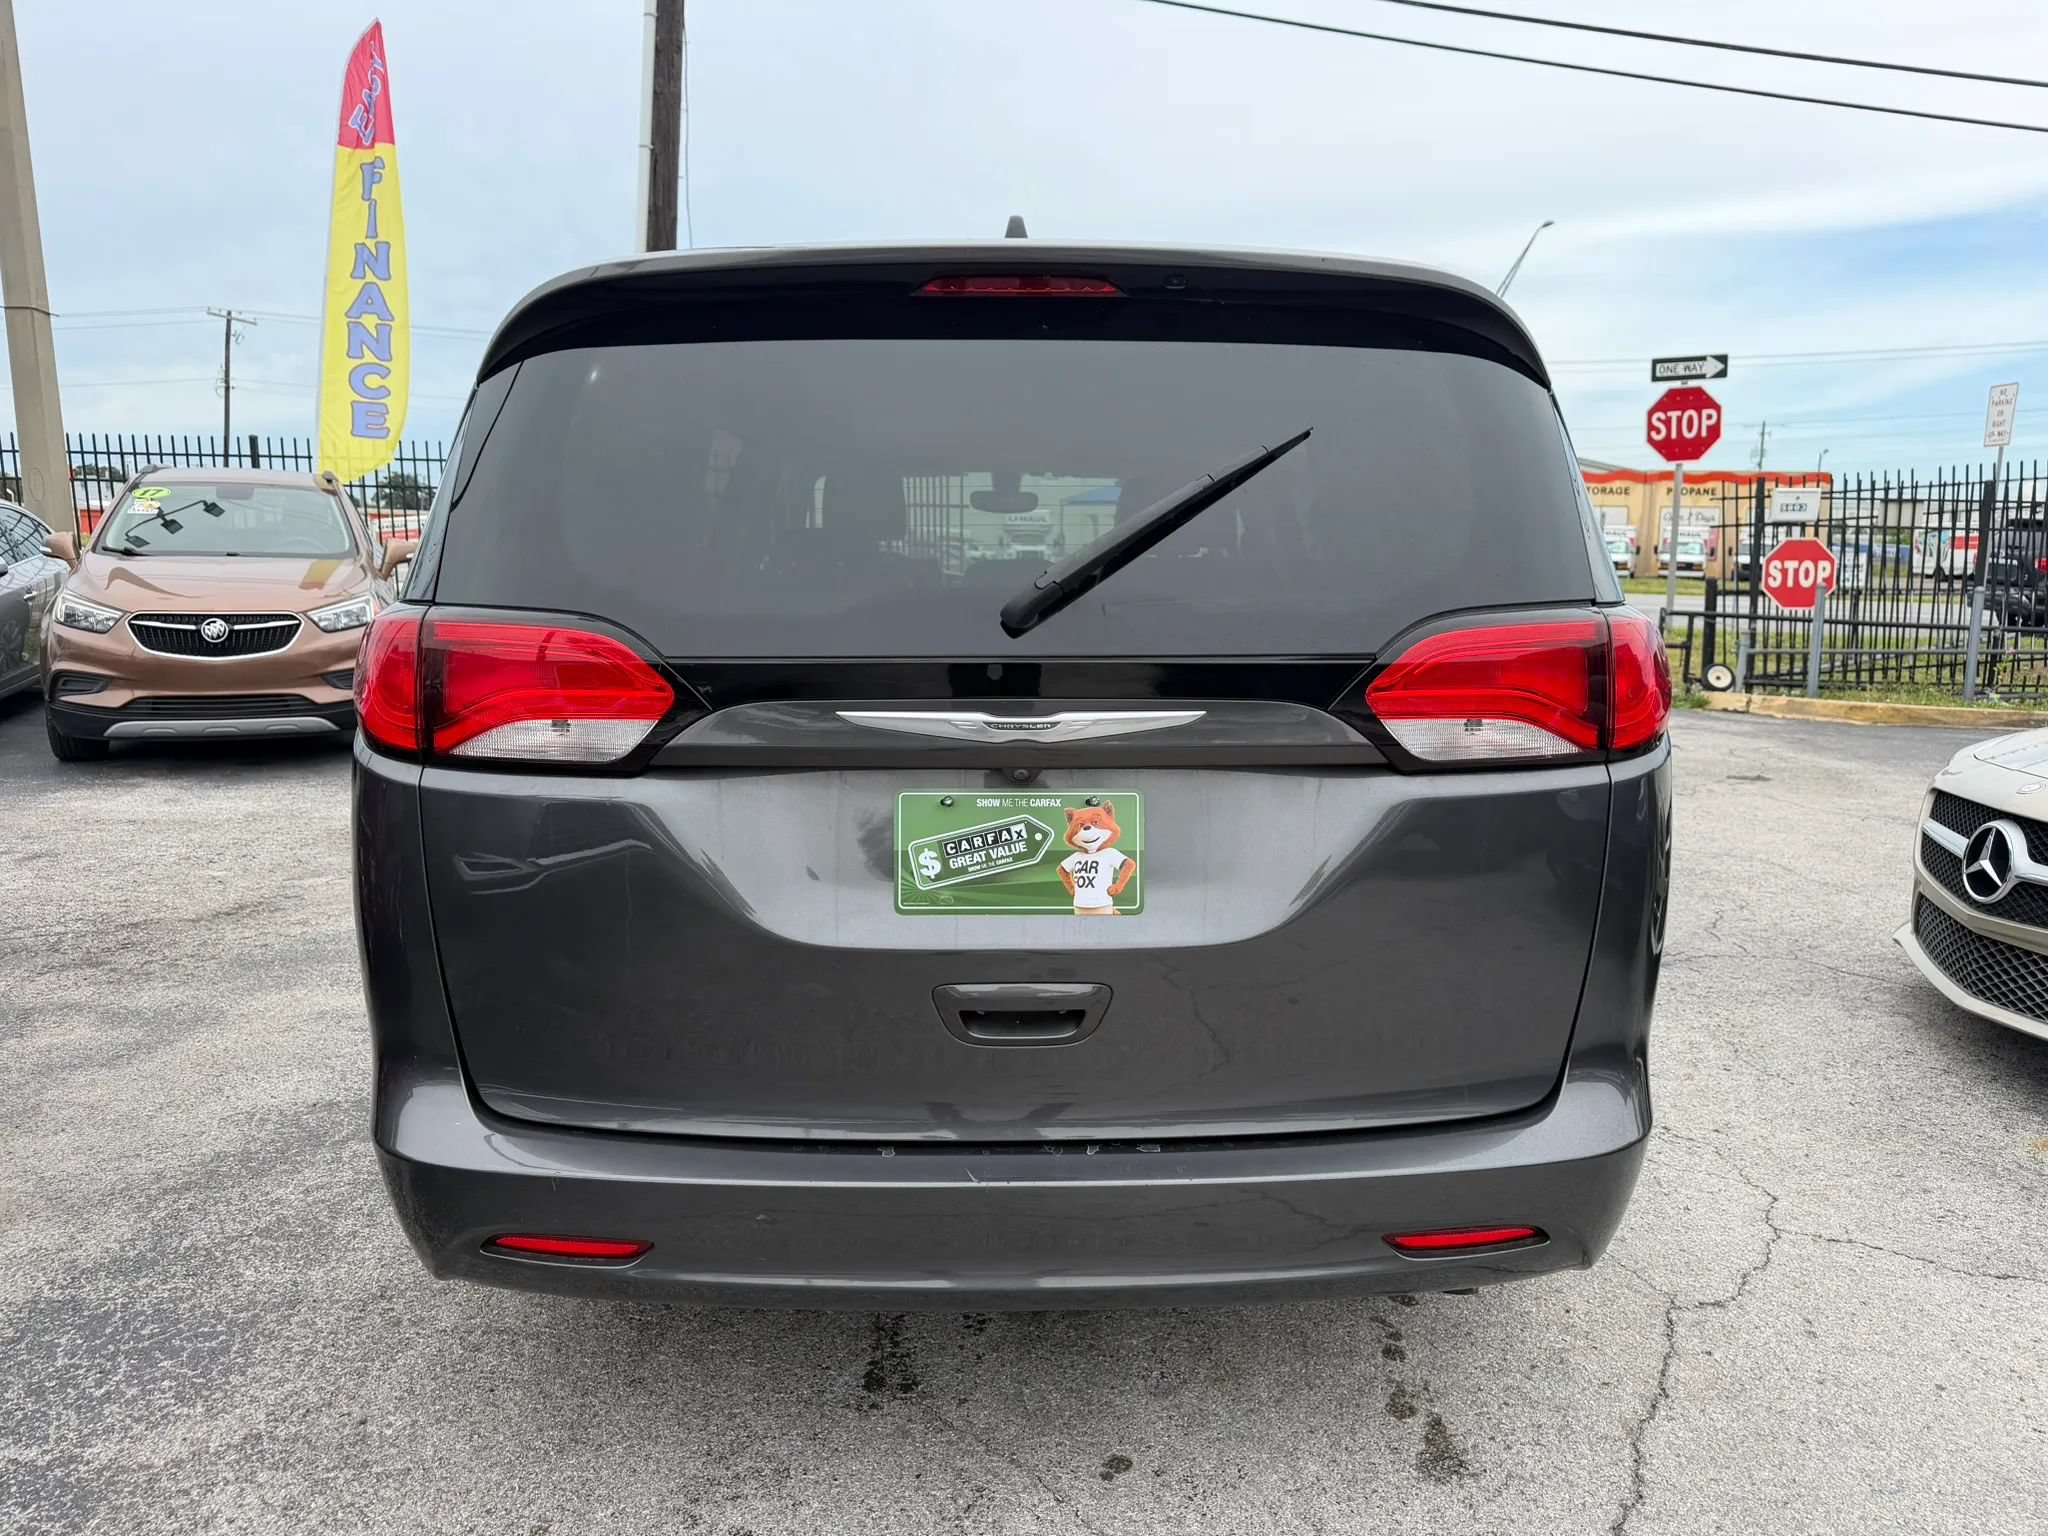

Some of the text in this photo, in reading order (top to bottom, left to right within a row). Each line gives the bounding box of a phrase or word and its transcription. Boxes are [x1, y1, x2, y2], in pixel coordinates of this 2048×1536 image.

[345, 156, 395, 439] FINANCE
[1658, 361, 1705, 374] ONE WAY
[1649, 408, 1718, 441] STOP
[1587, 486, 1631, 496] TORAGE
[1666, 487, 1718, 496] POPANE
[1767, 559, 1832, 588] STOP
[976, 798, 1062, 807] SHOW ME THE CARFAX
[944, 826, 1025, 855] CARFAX
[949, 841, 1028, 869] GREAT VALUE
[1074, 860, 1099, 874] CAR
